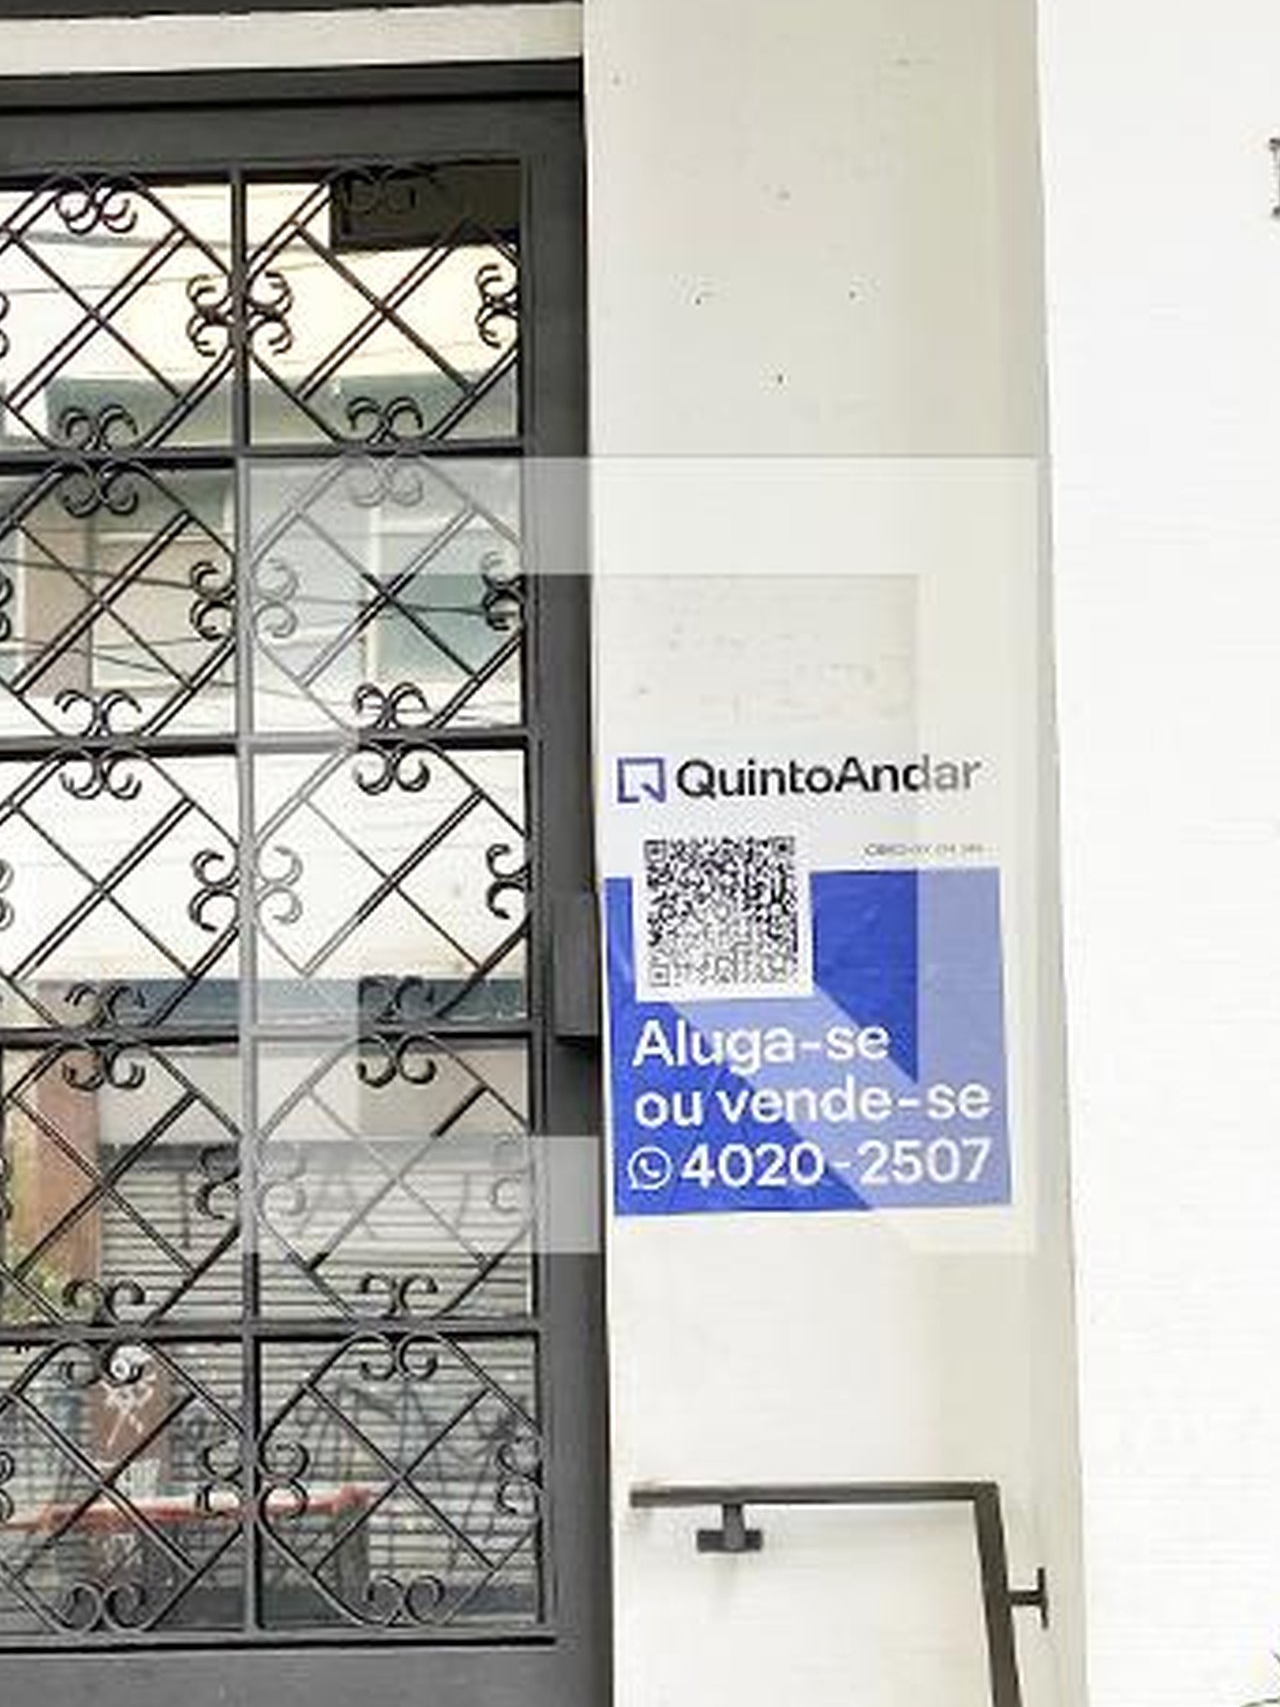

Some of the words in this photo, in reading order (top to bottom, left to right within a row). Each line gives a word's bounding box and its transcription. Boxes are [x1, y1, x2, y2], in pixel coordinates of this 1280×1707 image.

[675, 754, 982, 801] QuintoAndar
[632, 1018, 890, 1074] Aluga-se
[634, 1086, 703, 1128] ou
[717, 1077, 991, 1125] vende-se
[681, 1139, 990, 1189] 4020-2507
